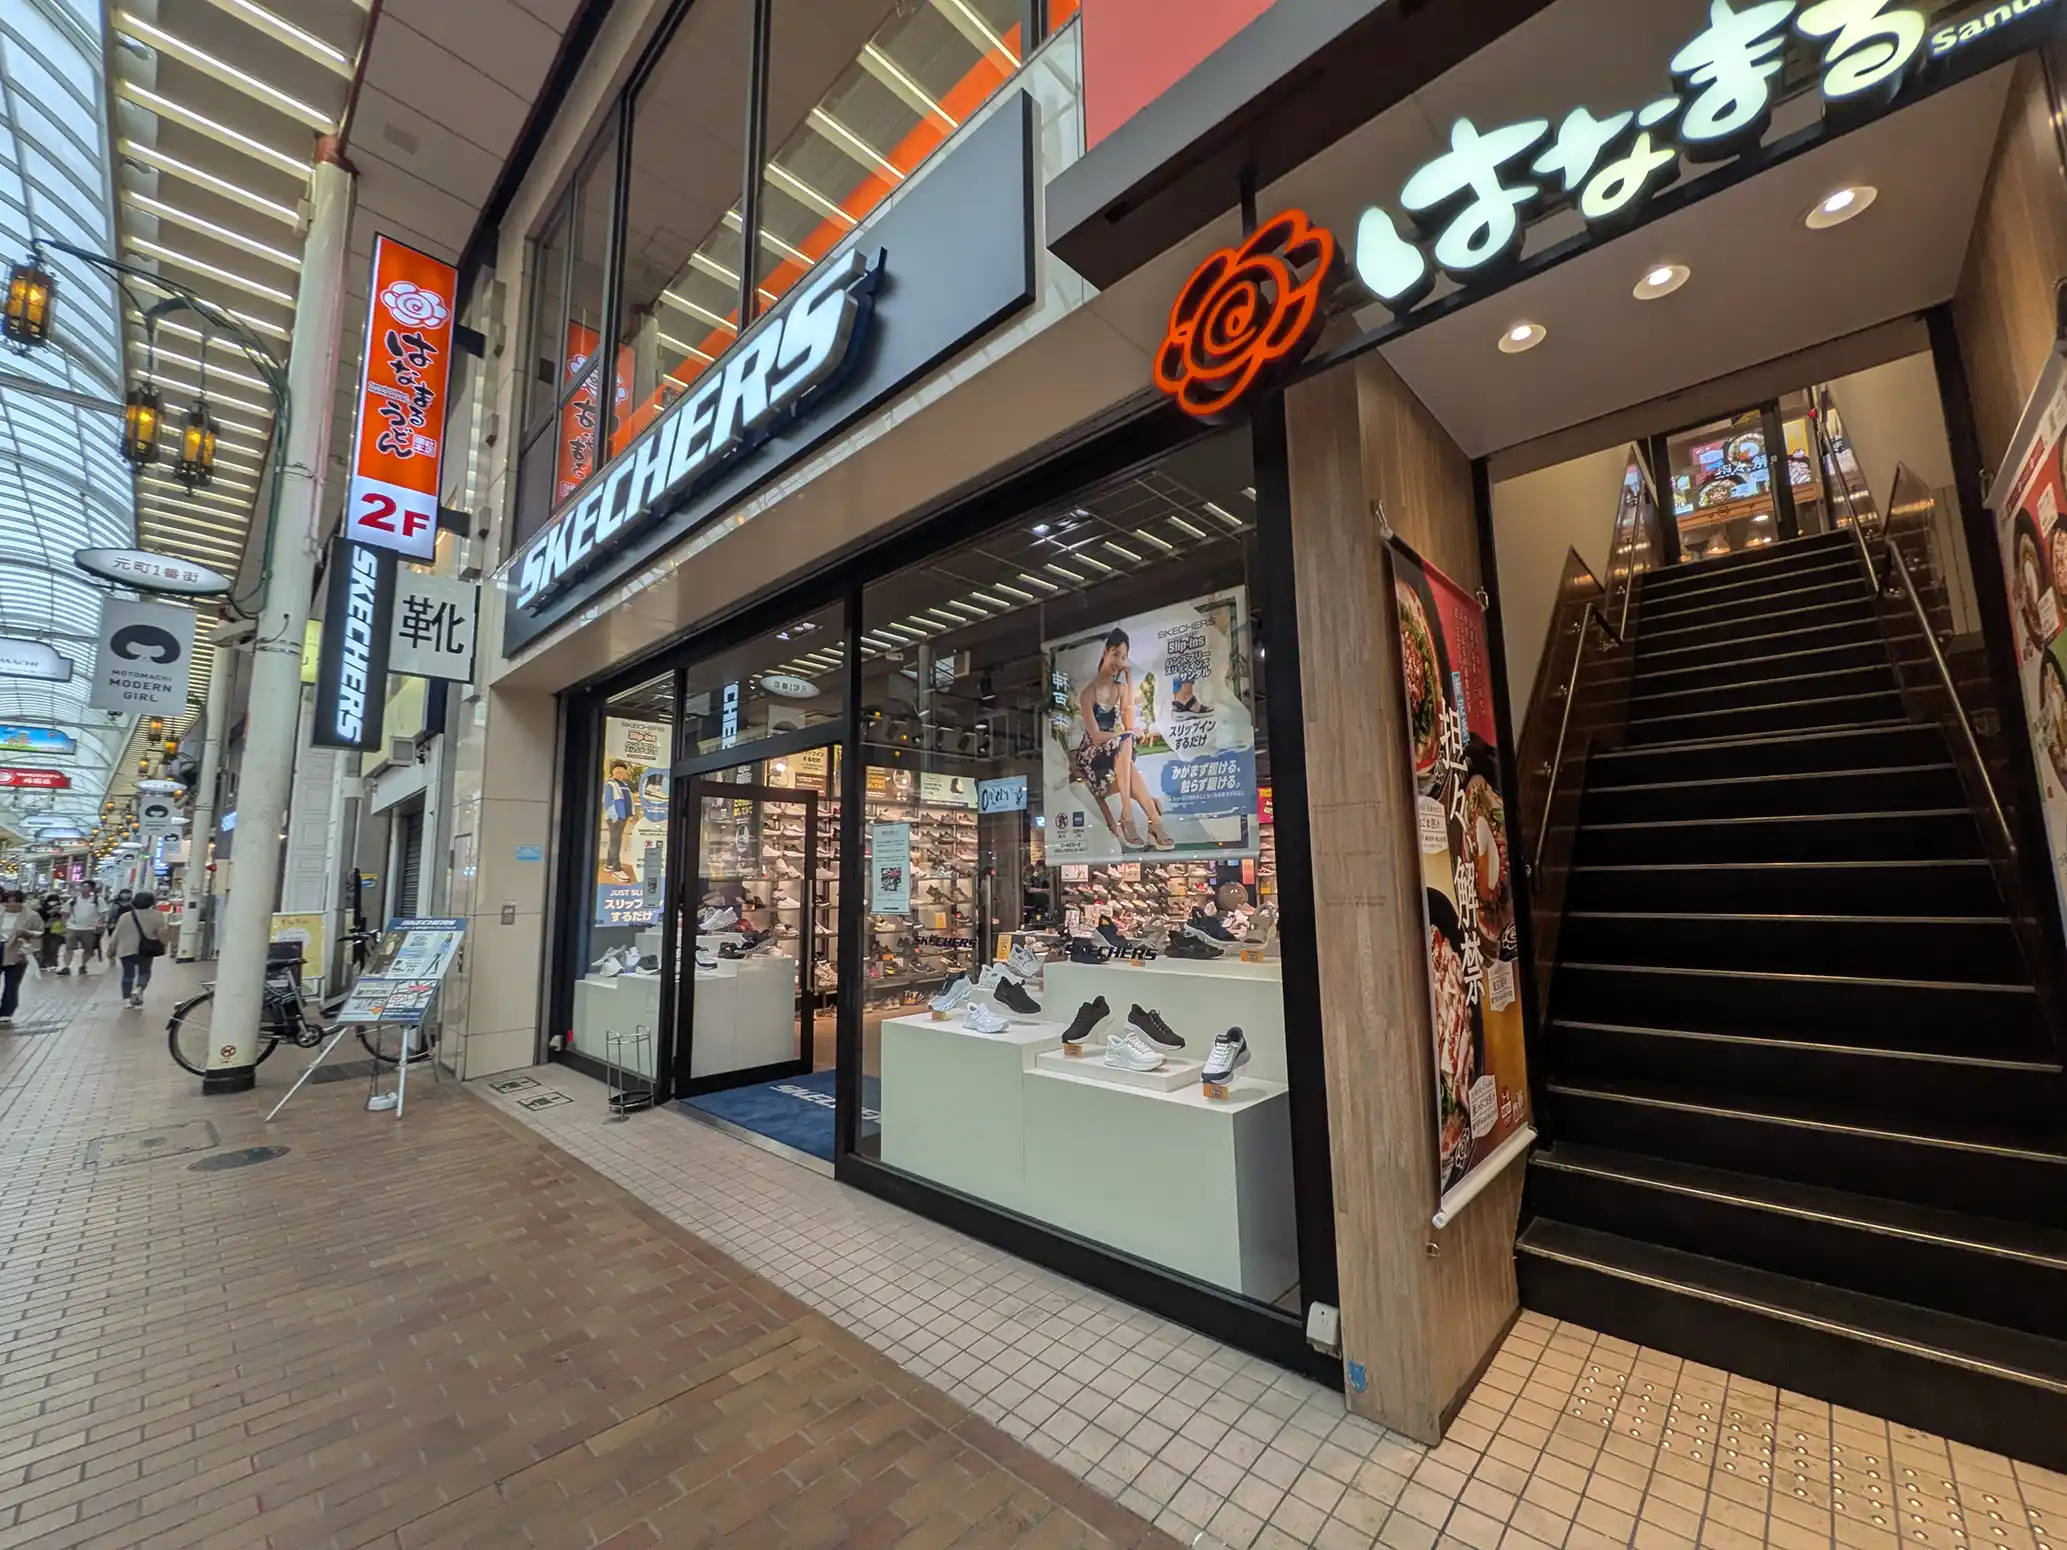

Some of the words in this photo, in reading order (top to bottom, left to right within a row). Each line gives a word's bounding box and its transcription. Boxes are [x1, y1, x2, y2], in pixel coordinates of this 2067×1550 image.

[1357, 0, 1927, 299] はなまる
[384, 329, 440, 428] はなまる
[376, 400, 416, 459] うどん
[516, 248, 868, 610] SKECHERS
[357, 493, 430, 536] 2F
[113, 556, 199, 583] 元町1番街
[399, 595, 465, 654] 靴
[1158, 617, 1217, 639] SKECHERS
[335, 545, 379, 743] SKECHERS
[109, 678, 172, 693] MODERN
[111, 669, 172, 682] MOTOMACHI
[123, 692, 159, 703] GIRL
[1169, 720, 1216, 737] スリップイン
[1175, 734, 1207, 750] するだけ
[609, 889, 630, 897] JUST
[611, 910, 653, 923] するだけ
[914, 935, 977, 948] SKECHERS
